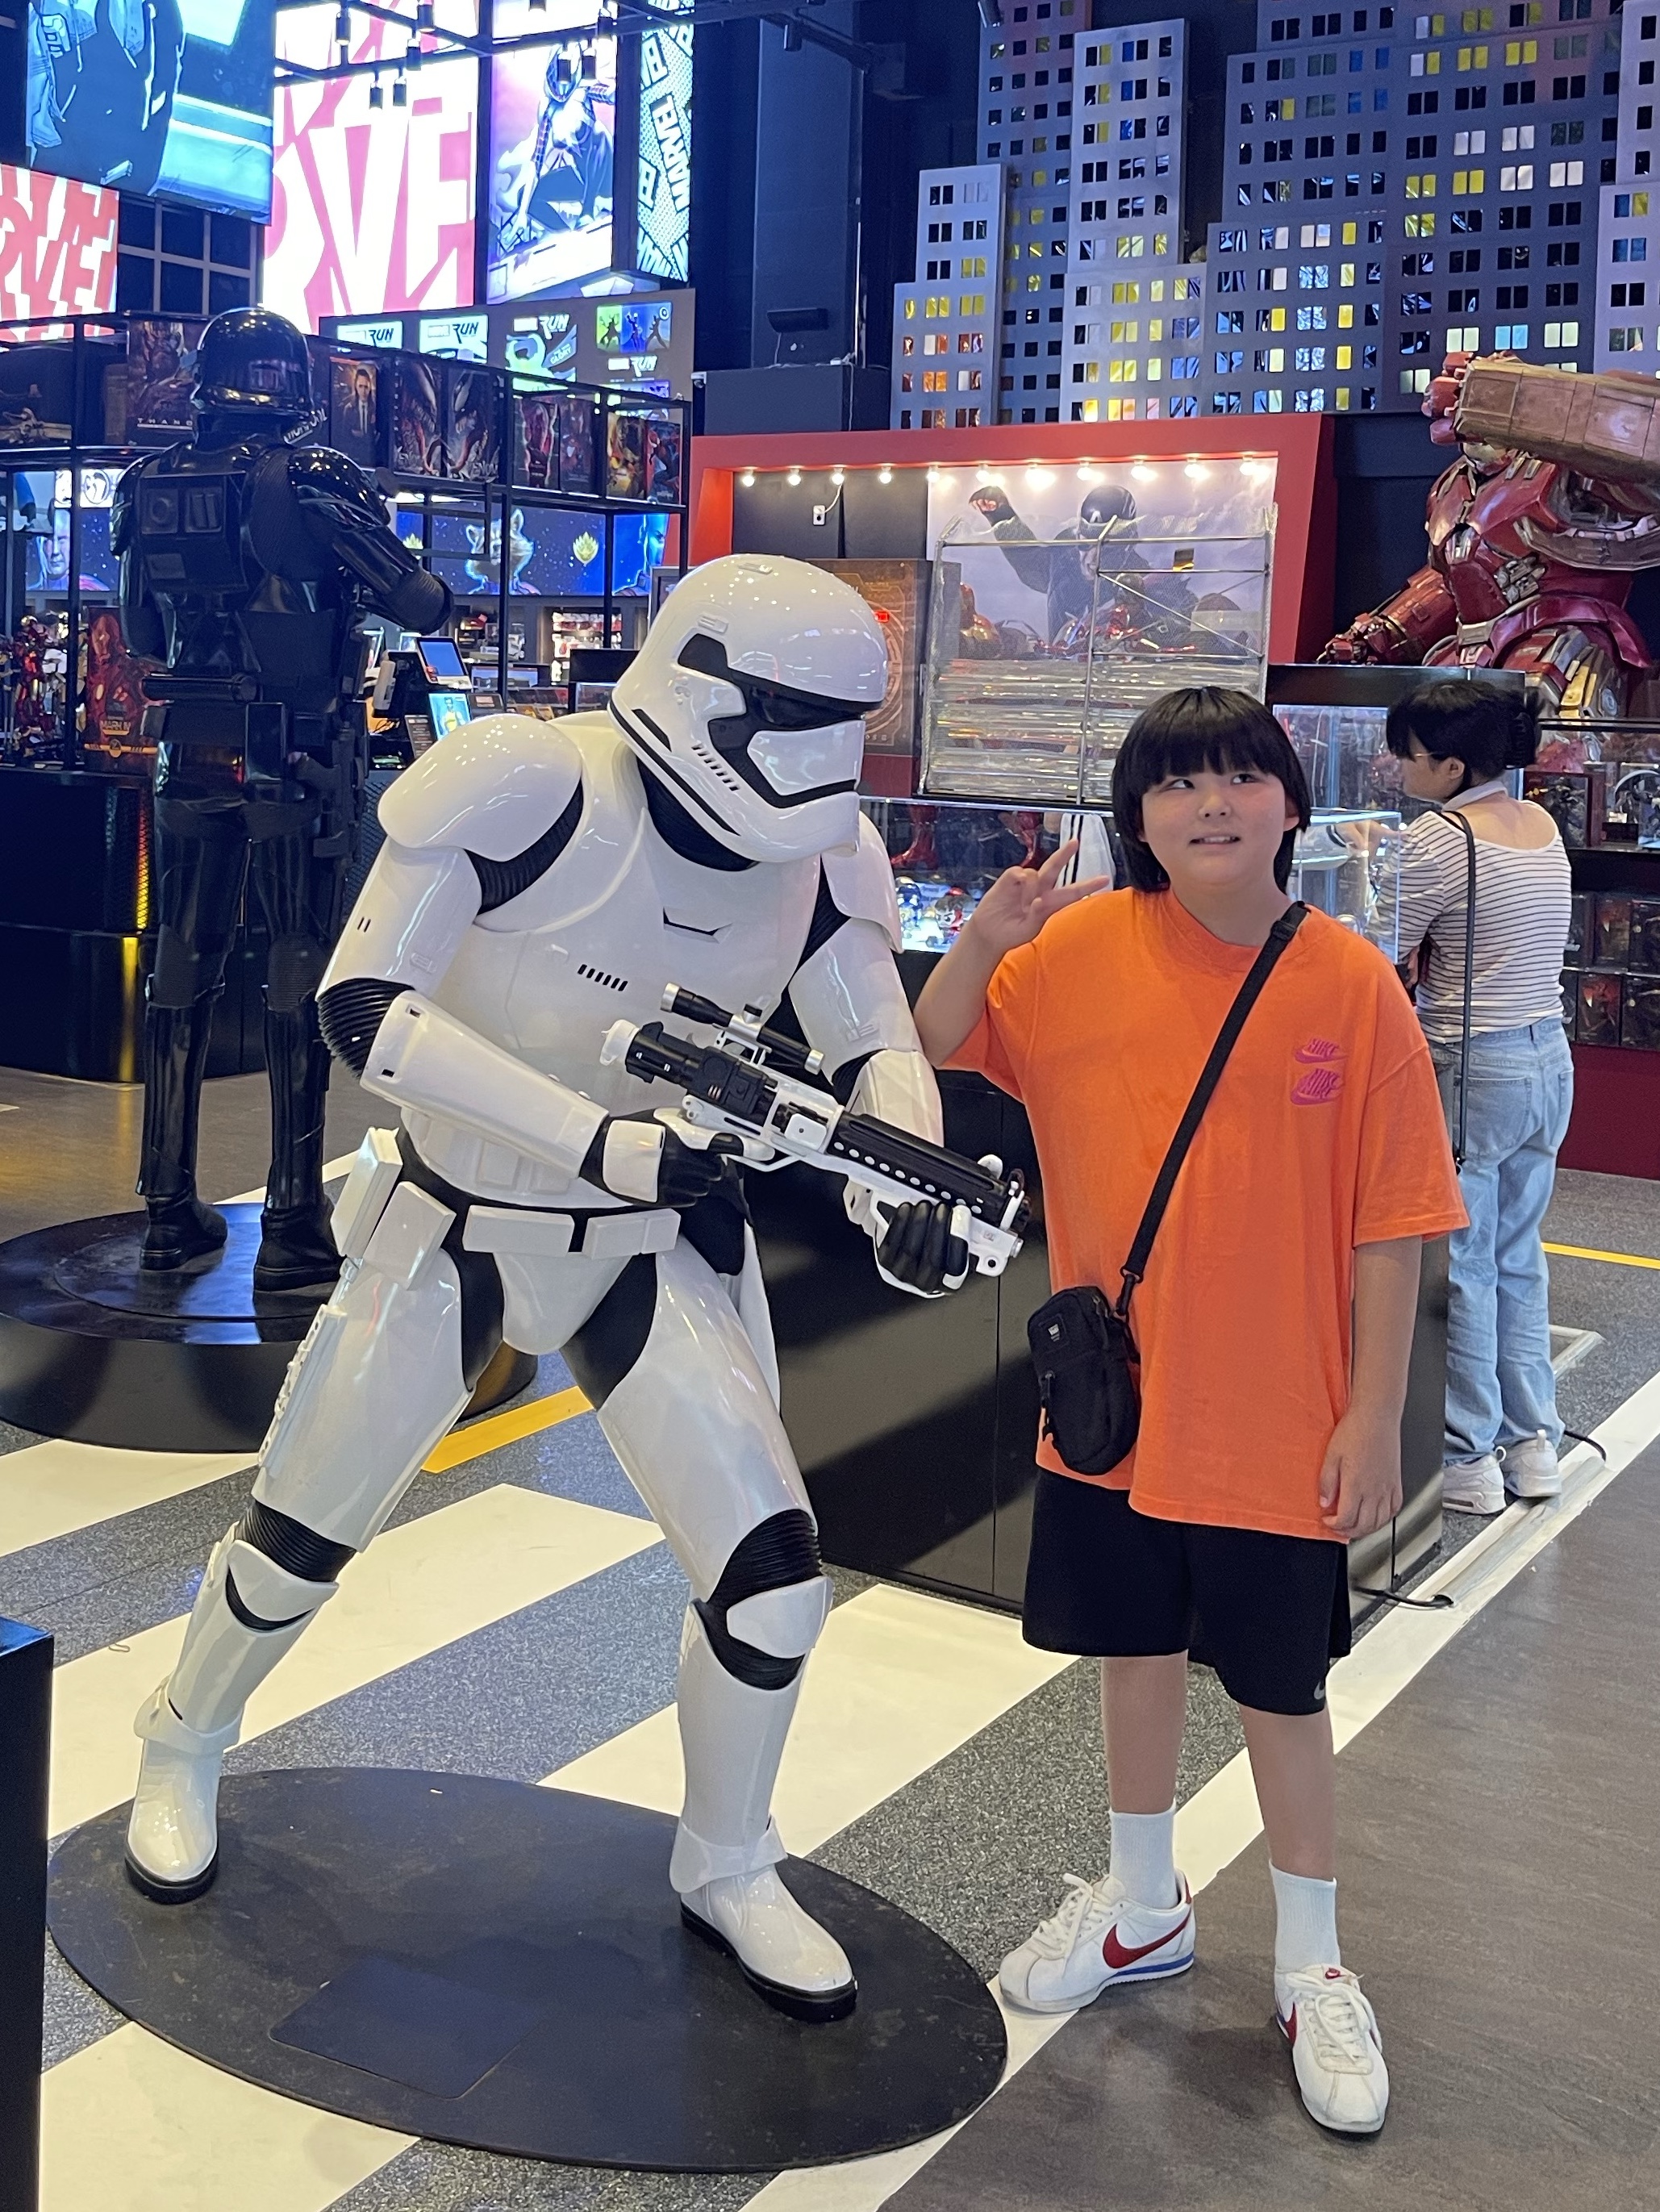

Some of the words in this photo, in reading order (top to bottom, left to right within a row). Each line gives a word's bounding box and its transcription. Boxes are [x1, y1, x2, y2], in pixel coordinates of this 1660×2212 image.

[649, 93, 690, 213] MARVEL
[368, 328, 394, 347] RUN
[452, 321, 479, 344] RUN
[538, 313, 570, 340] RUN
[629, 354, 658, 377] RUN
